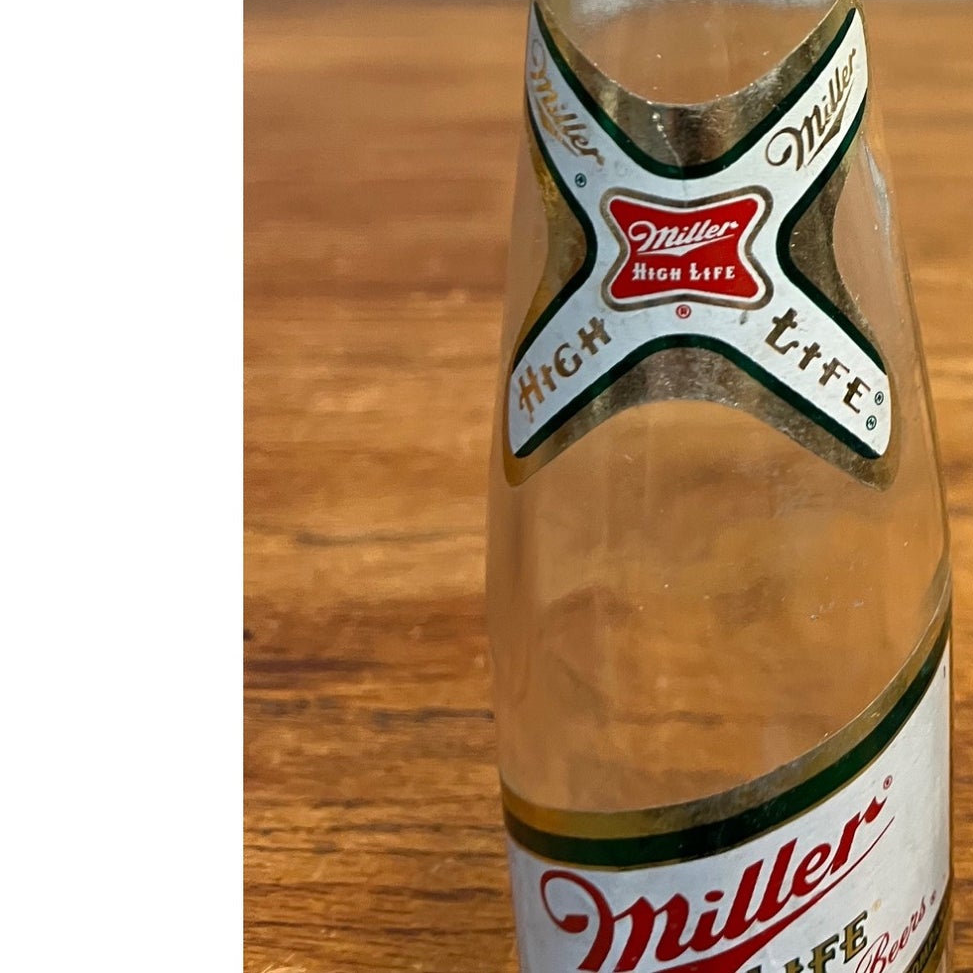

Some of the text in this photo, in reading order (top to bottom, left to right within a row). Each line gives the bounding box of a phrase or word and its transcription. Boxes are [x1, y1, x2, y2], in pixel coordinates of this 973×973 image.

[532, 39, 604, 166] Miller
[765, 48, 856, 170] Miller
[628, 219, 739, 257] Miller
[540, 795, 890, 973] Miller
